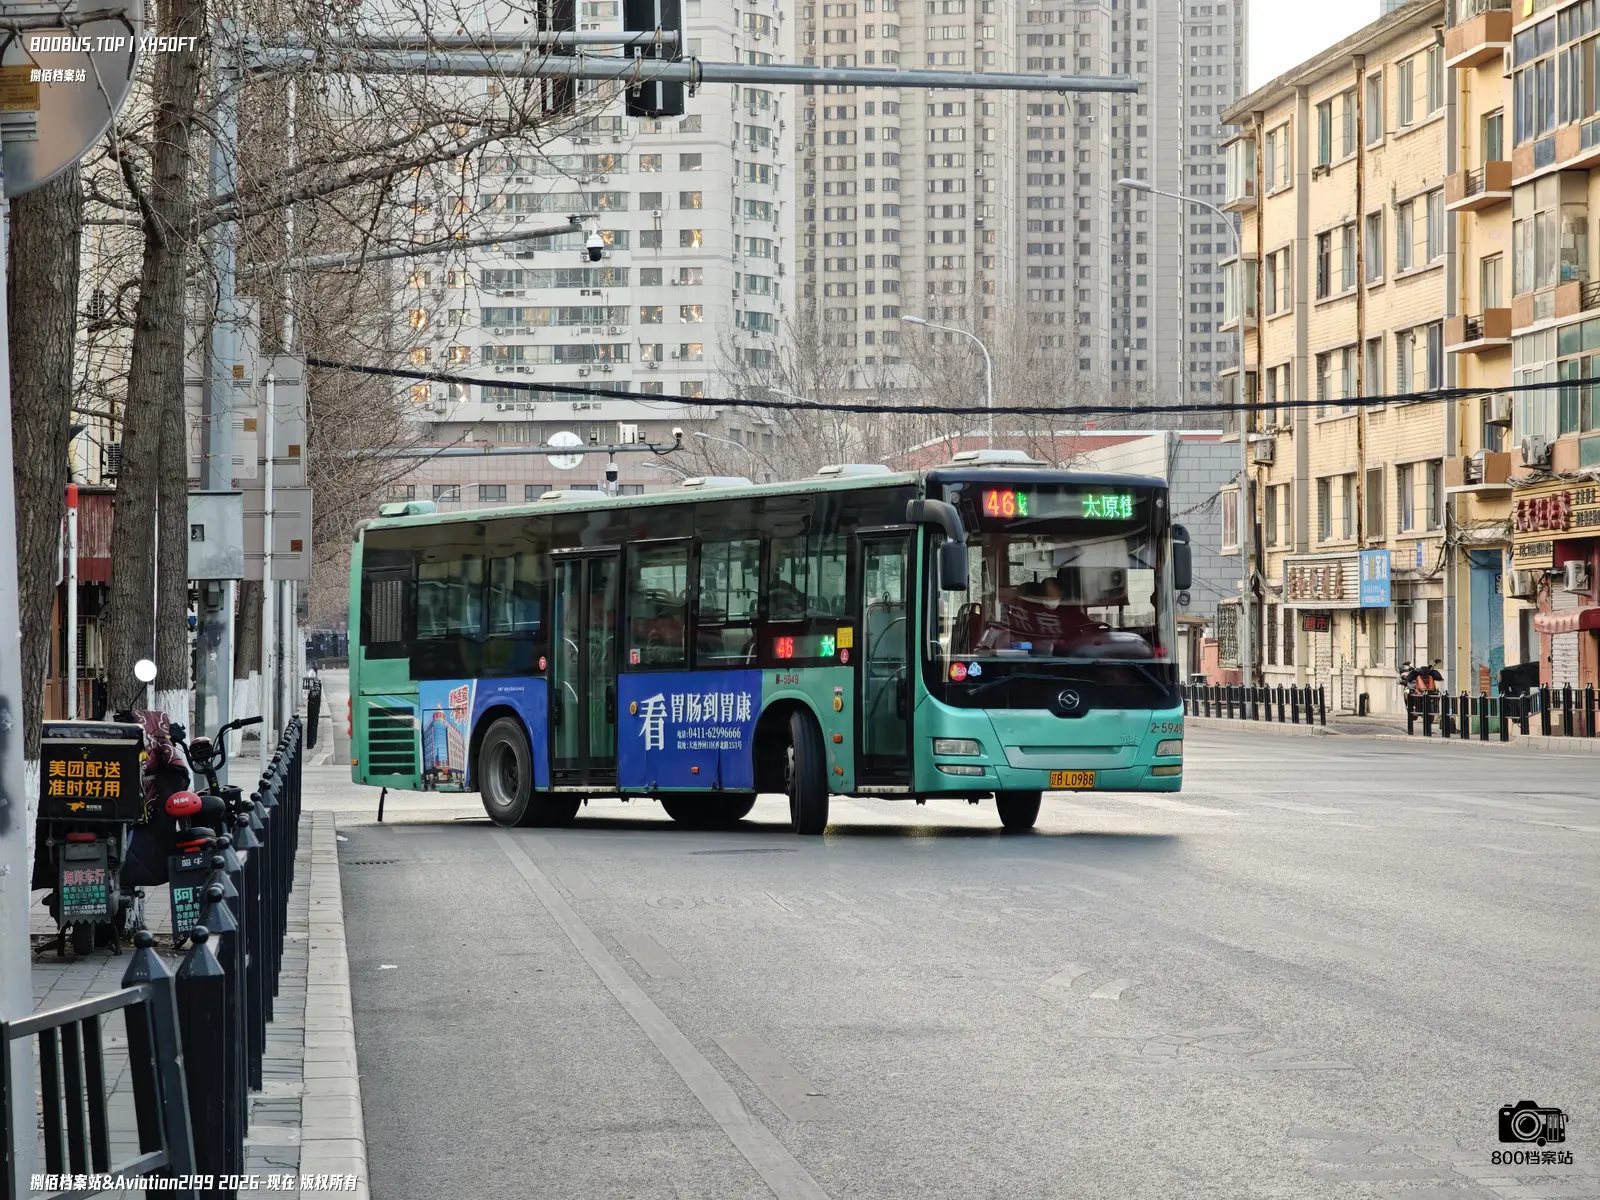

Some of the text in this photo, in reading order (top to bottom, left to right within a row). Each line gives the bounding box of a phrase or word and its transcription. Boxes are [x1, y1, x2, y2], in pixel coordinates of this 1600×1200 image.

[638, 691, 752, 751] 看 胃肠到胃康
[49, 760, 121, 778] 美团配送
[48, 779, 120, 798] 准时好用
